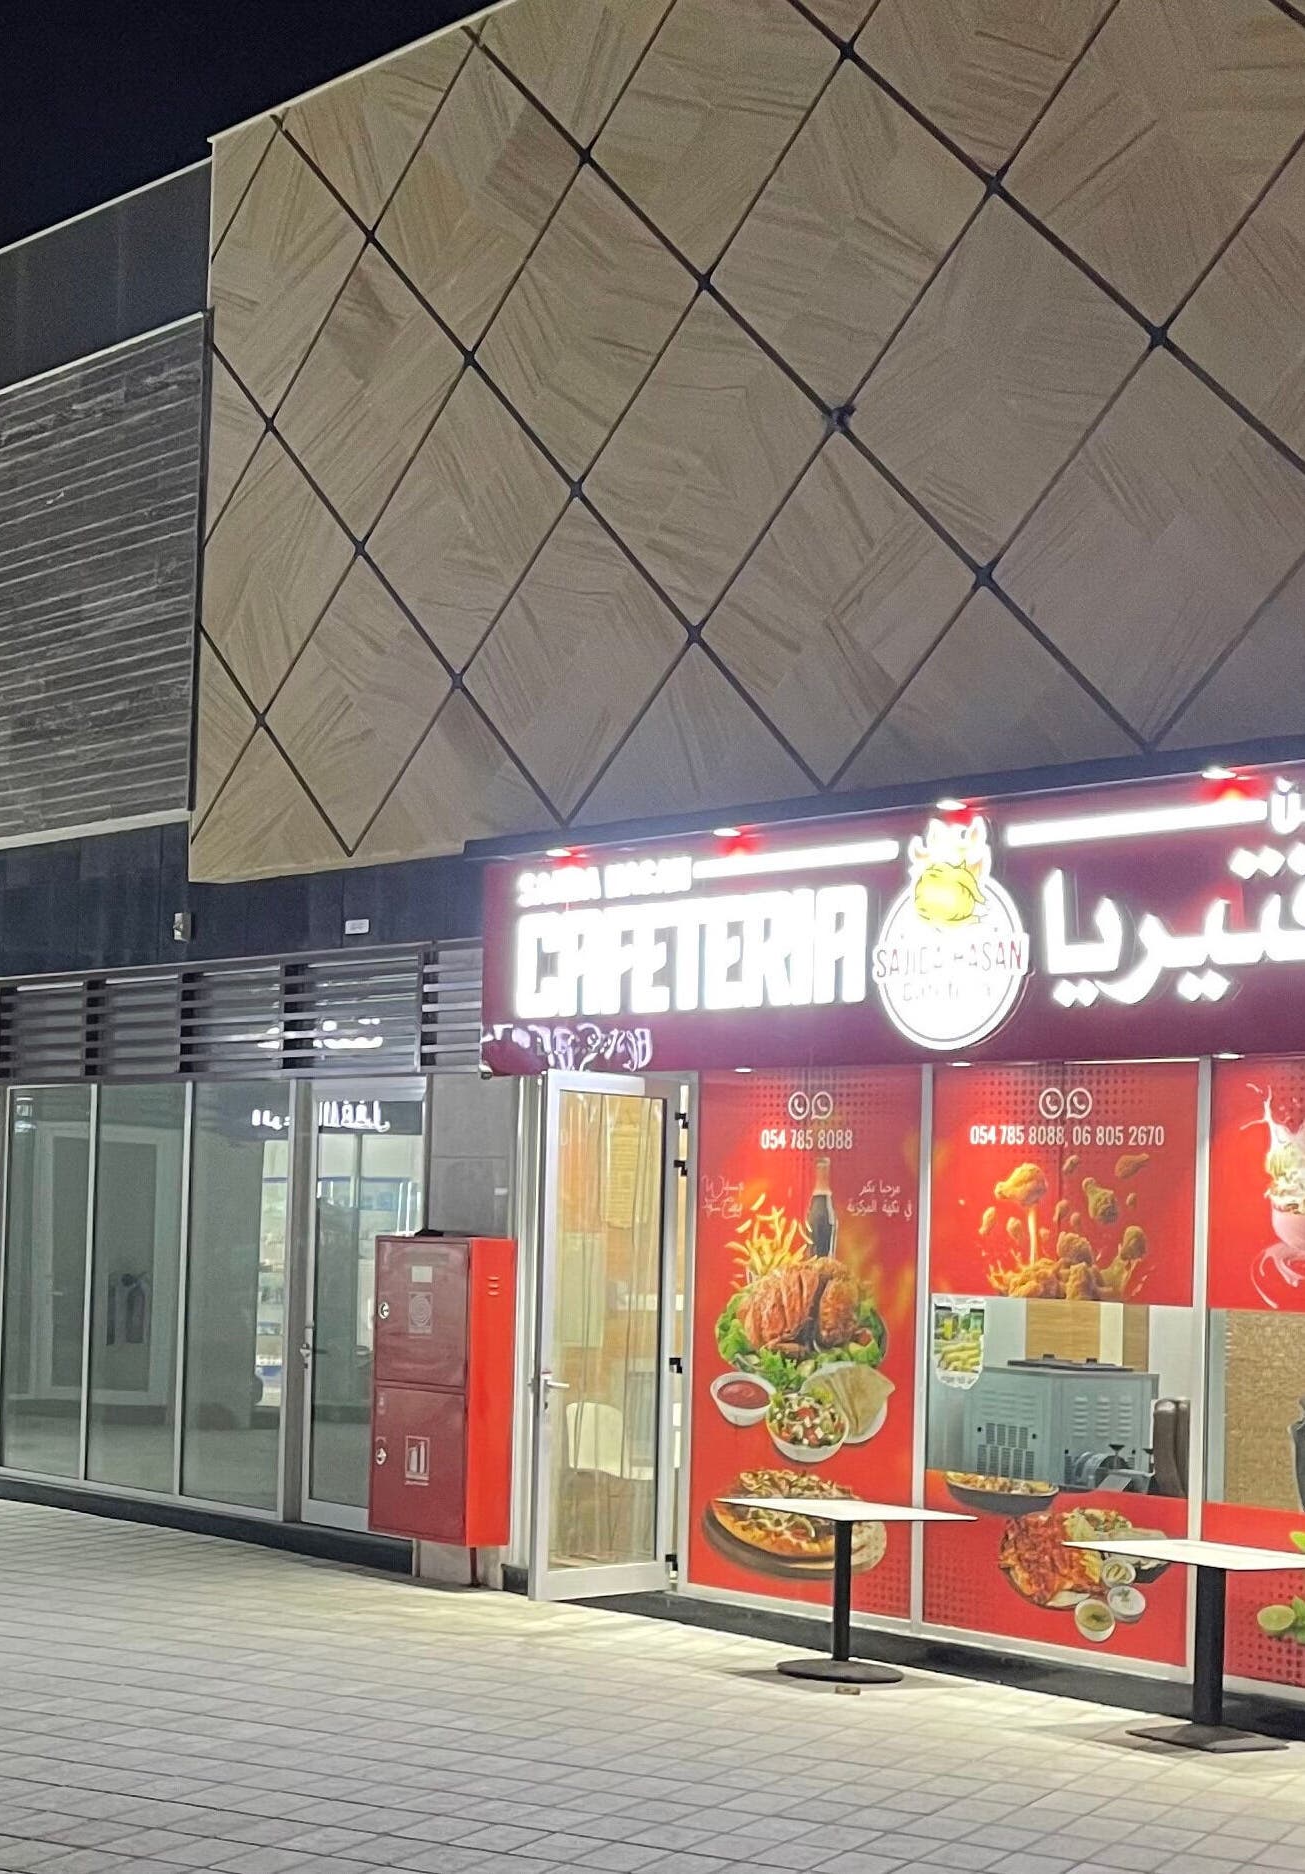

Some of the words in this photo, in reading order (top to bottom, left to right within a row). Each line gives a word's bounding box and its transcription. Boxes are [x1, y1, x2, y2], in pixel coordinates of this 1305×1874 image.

[516, 885, 867, 1018] CAFETERIA
[953, 939, 1022, 972] ASAN
[760, 1129, 786, 1150] 054
[790, 1129, 813, 1150] 785
[818, 1129, 853, 1150] 8088
[970, 1126, 995, 1145] 054
[1000, 1126, 1024, 1145] 785
[1072, 1126, 1091, 1145] 06
[1096, 1126, 1124, 1145] 805
[1128, 1126, 1164, 1146] 2670
